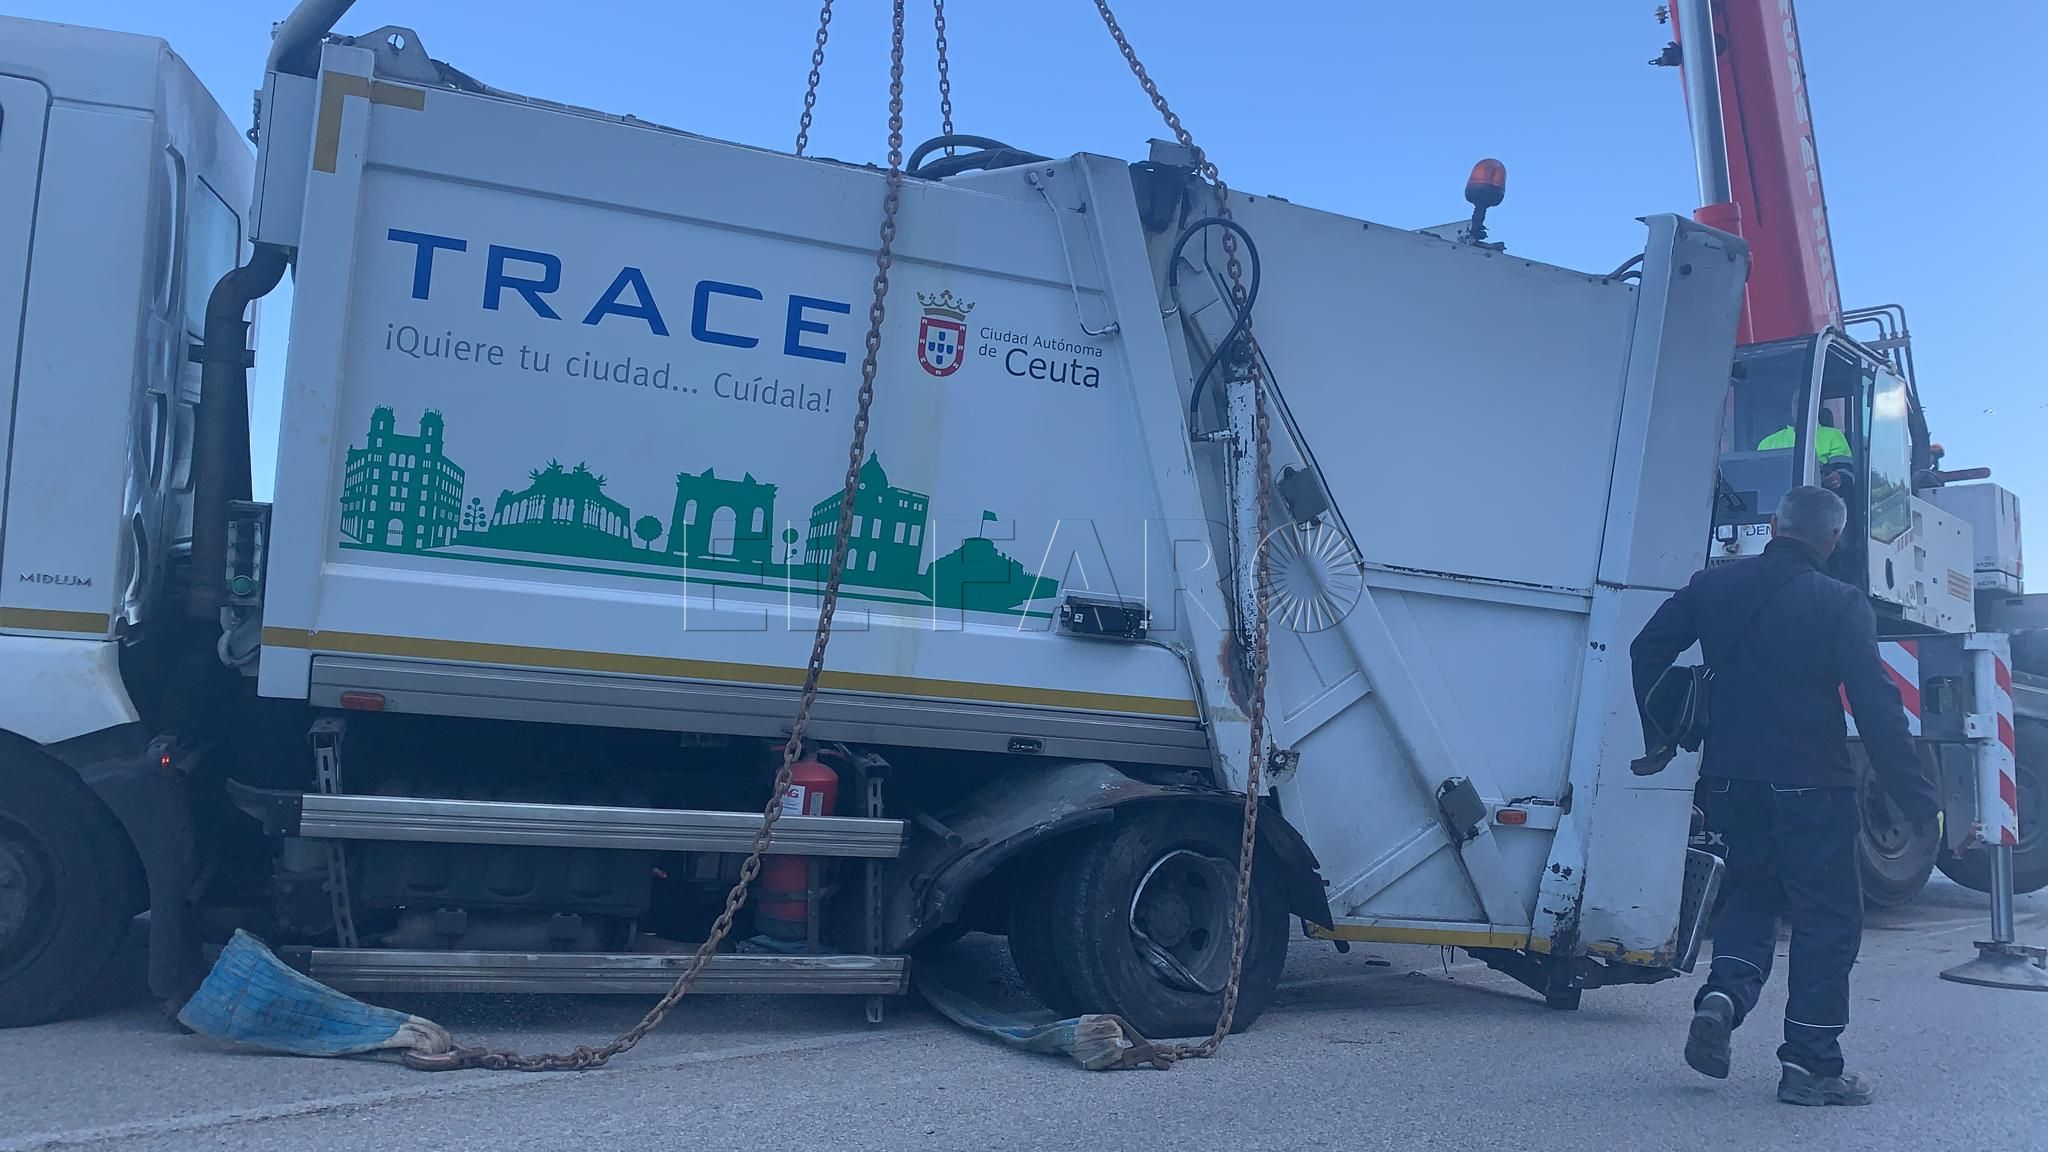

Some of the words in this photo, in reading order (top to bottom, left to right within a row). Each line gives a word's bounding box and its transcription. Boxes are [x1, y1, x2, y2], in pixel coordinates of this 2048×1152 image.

[387, 227, 851, 365] TRACE
[980, 327, 1028, 345] Ciudad
[1033, 335, 1103, 358] Autónoma
[384, 322, 505, 366] ¡Quiere
[519, 343, 551, 374] tu
[565, 349, 698, 394] ciudad...
[713, 371, 832, 413] Cuídala!
[978, 343, 997, 358] de
[1005, 348, 1101, 388] Ceuta
[20, 572, 92, 587] MIDLUM
